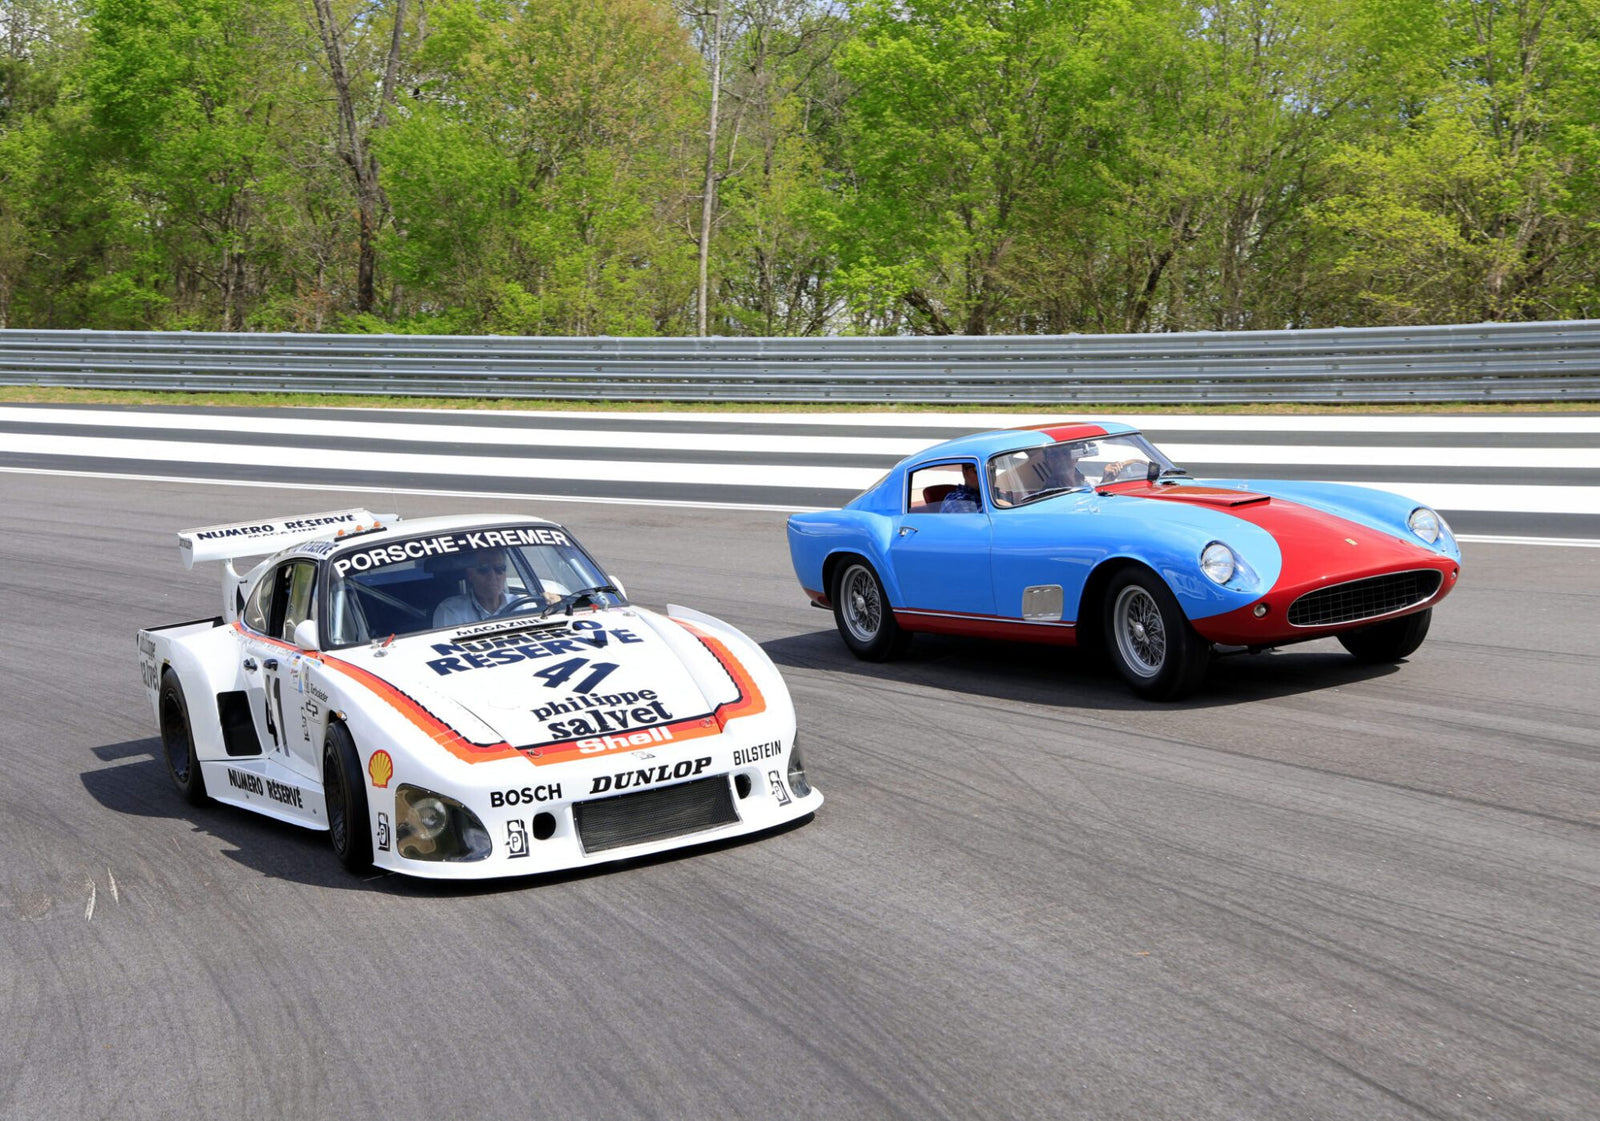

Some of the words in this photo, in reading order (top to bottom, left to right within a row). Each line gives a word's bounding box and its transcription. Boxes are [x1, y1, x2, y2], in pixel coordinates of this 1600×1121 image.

[197, 524, 274, 540] NUMERO
[333, 529, 571, 578] PORSCHE-KREMER
[430, 620, 603, 656] NUMERO
[456, 618, 544, 636] MAGAZINE
[533, 657, 621, 695] 41
[530, 689, 659, 722] philippe
[547, 700, 674, 740] salvet
[576, 726, 674, 754] Shell
[733, 739, 782, 767] BILSTEIN
[228, 768, 264, 796] NUMERO
[589, 756, 712, 795] DUNLOP
[490, 783, 563, 808] BOSCH
